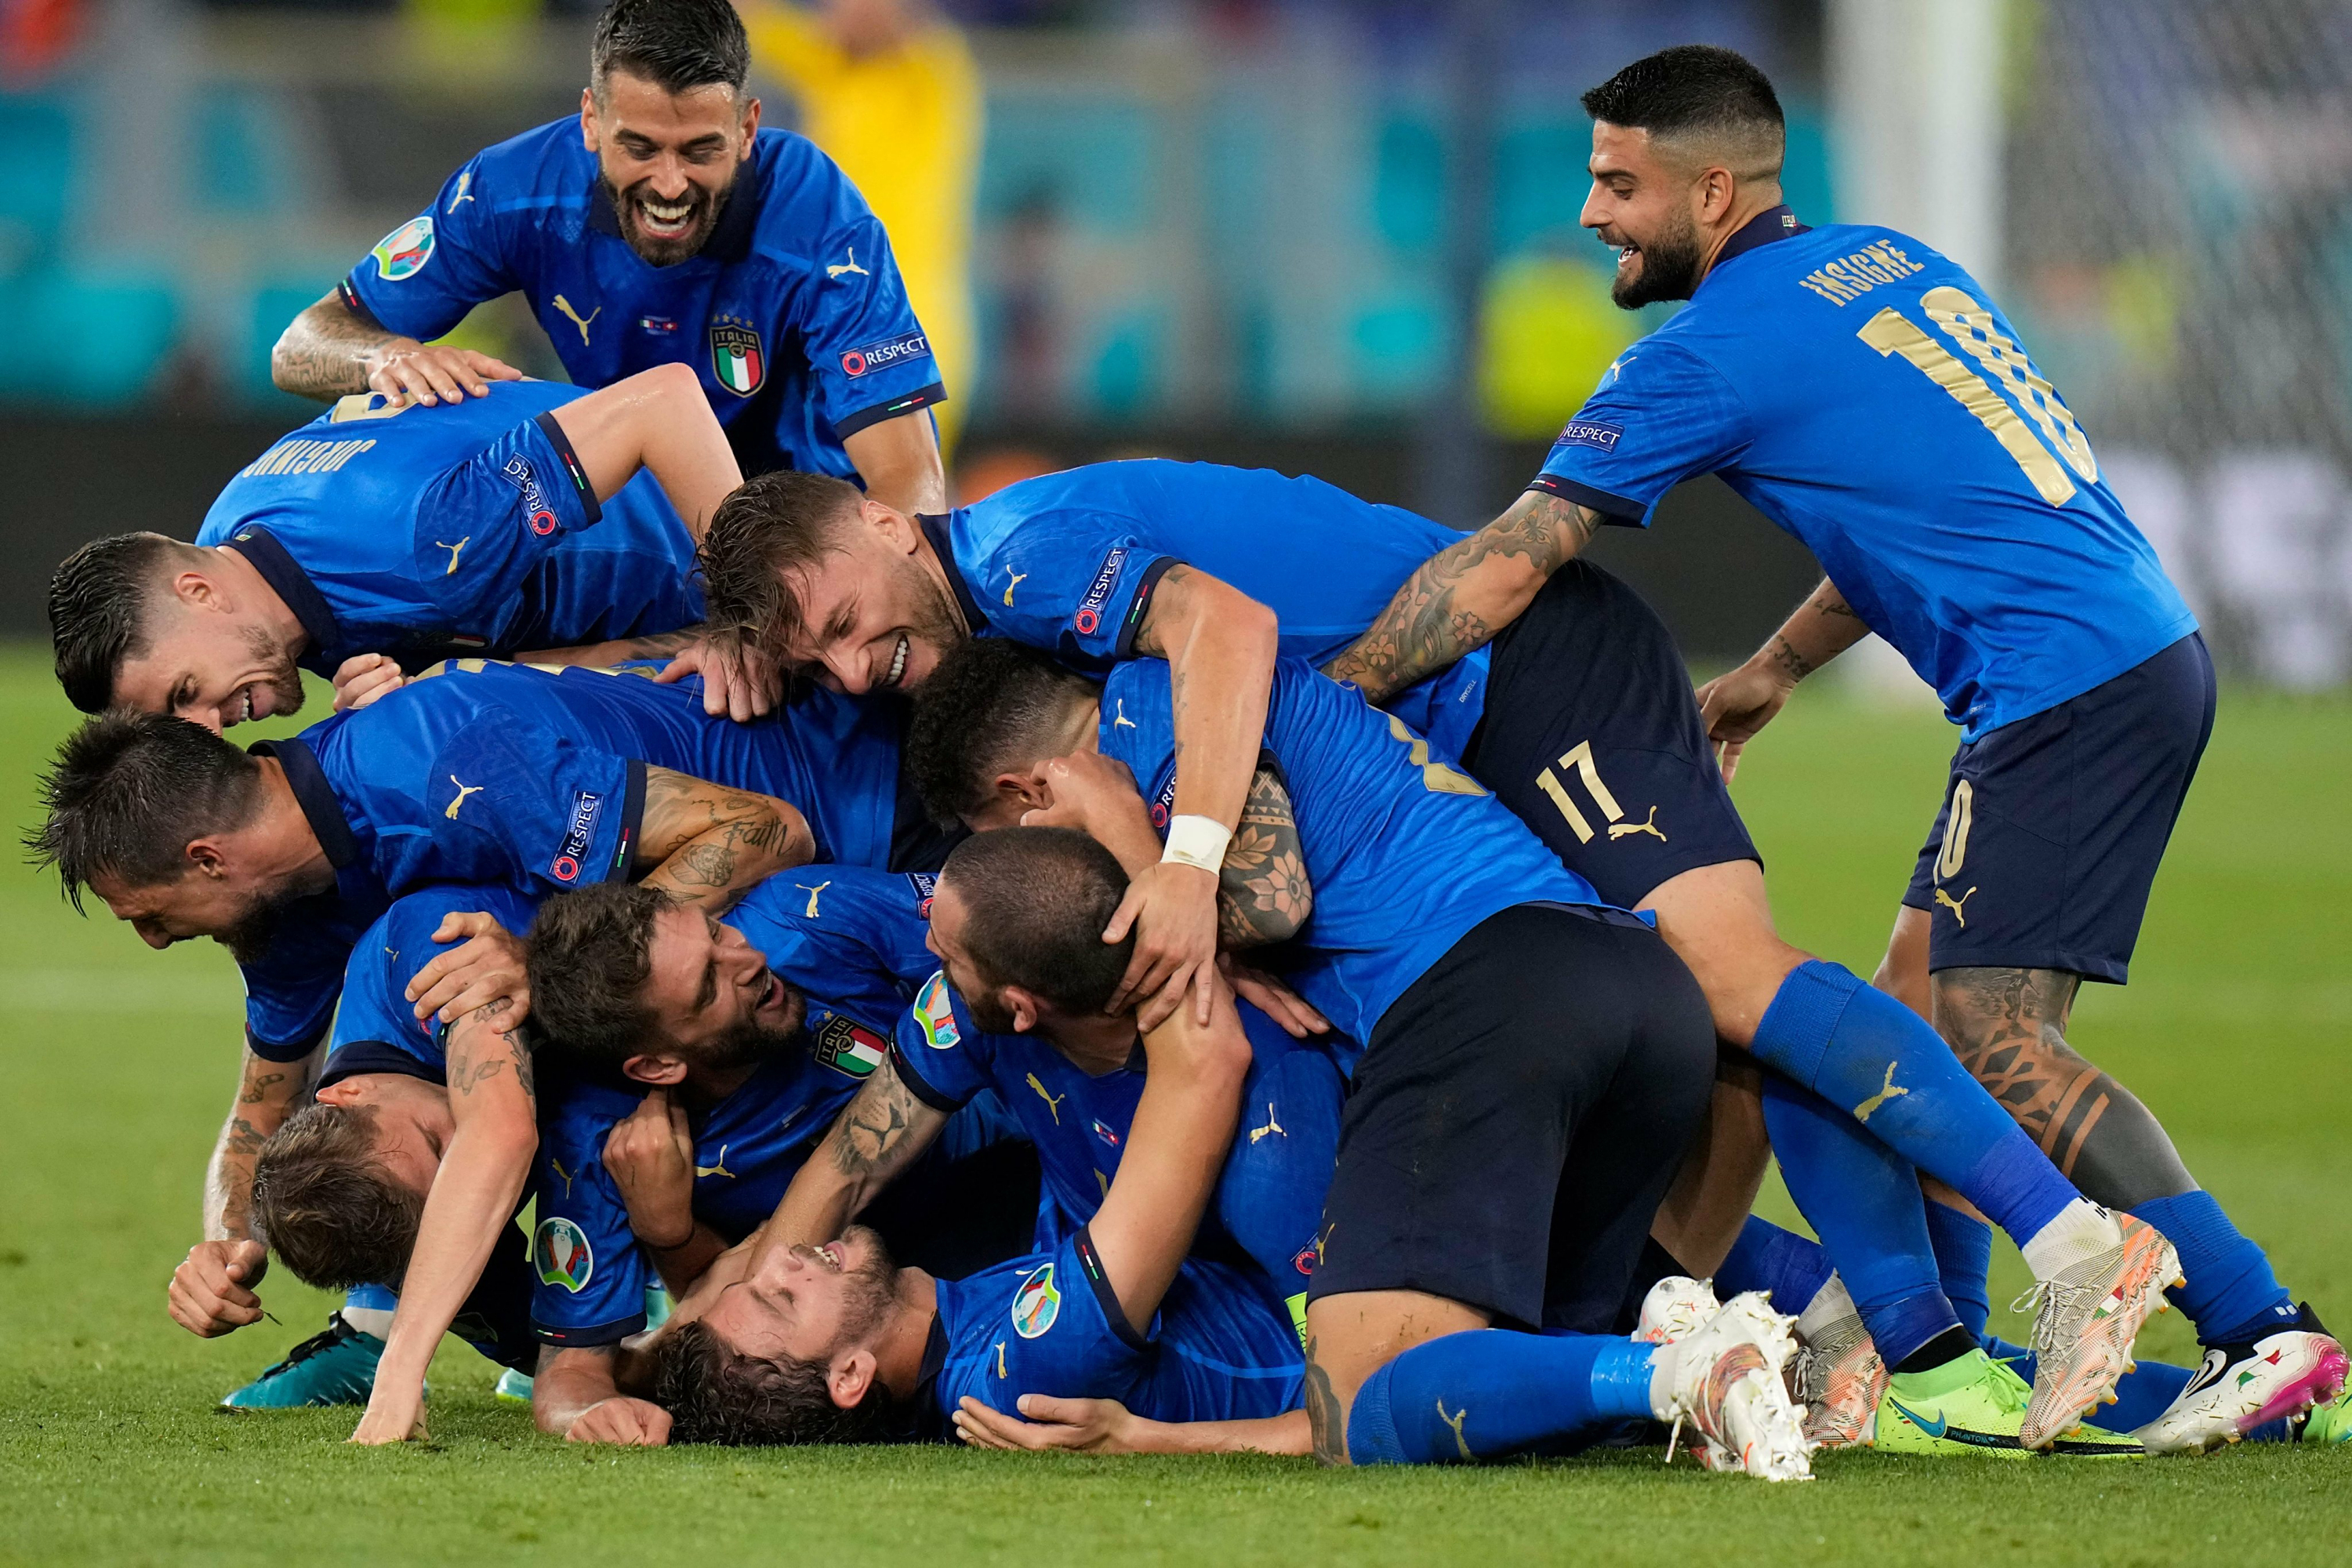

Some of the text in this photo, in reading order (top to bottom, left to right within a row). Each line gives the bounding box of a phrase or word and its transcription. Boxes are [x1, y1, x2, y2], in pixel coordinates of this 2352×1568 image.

[1798, 239, 1925, 307] INSIGNE
[714, 331, 756, 345] ITALIA
[865, 336, 925, 365] RESPECT
[1856, 286, 2099, 508] 10
[1563, 426, 1621, 445] RESPECT
[1086, 548, 1122, 608] RESPECT
[1458, 680, 1477, 702] DRYCELL
[1535, 739, 1624, 844] 17
[566, 791, 596, 856] RESPECT
[720, 815, 797, 857] Faith
[820, 1019, 850, 1060] ITALIA
[1951, 1430, 1988, 1443] PHANTOM
